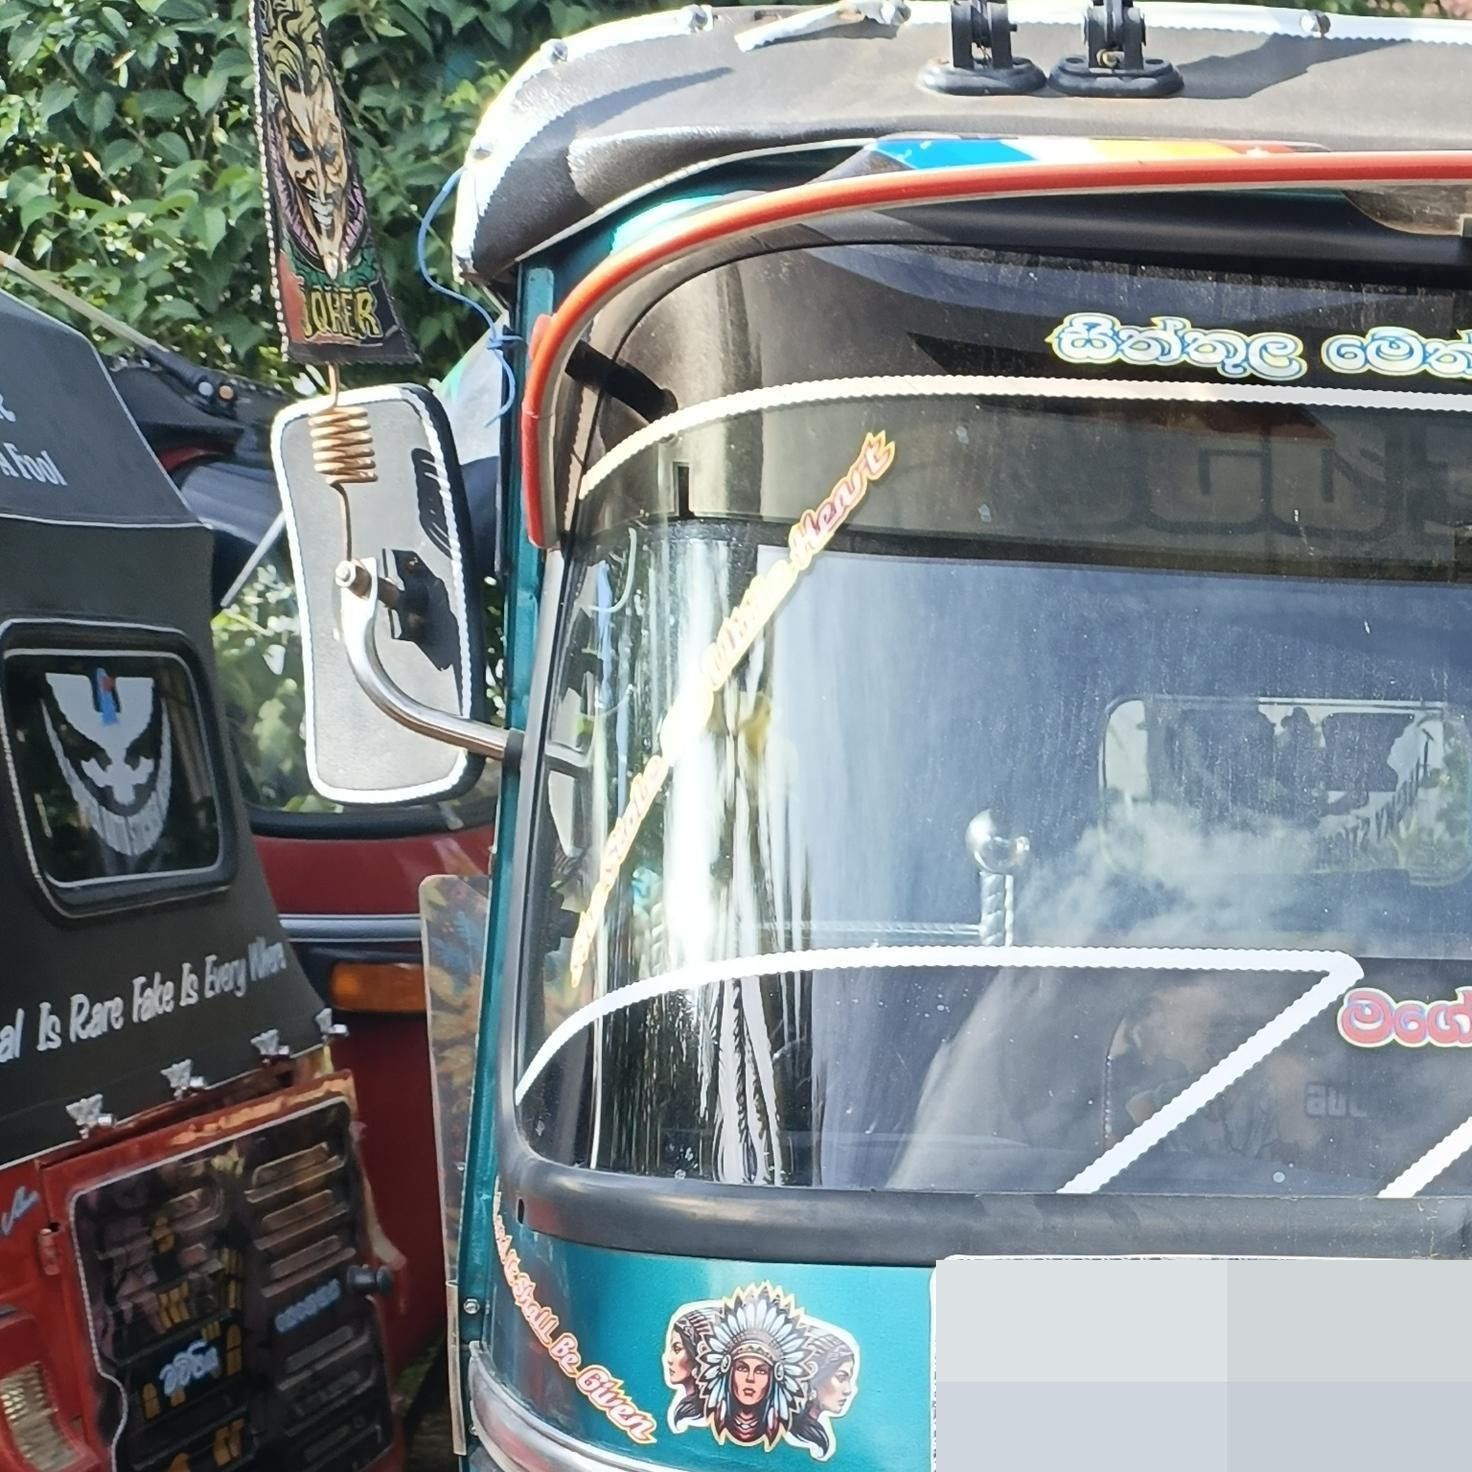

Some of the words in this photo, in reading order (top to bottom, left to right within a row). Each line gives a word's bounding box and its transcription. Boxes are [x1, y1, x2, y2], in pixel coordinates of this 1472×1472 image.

[37, 1002, 62, 1051] Is
[70, 993, 125, 1042] Rare
[132, 971, 175, 1024] Fake
[180, 962, 200, 1006] Is
[204, 954, 247, 998] Every
[514, 1272, 561, 1346] Shall
[550, 1332, 581, 1377] Be
[577, 1364, 657, 1445] Given
